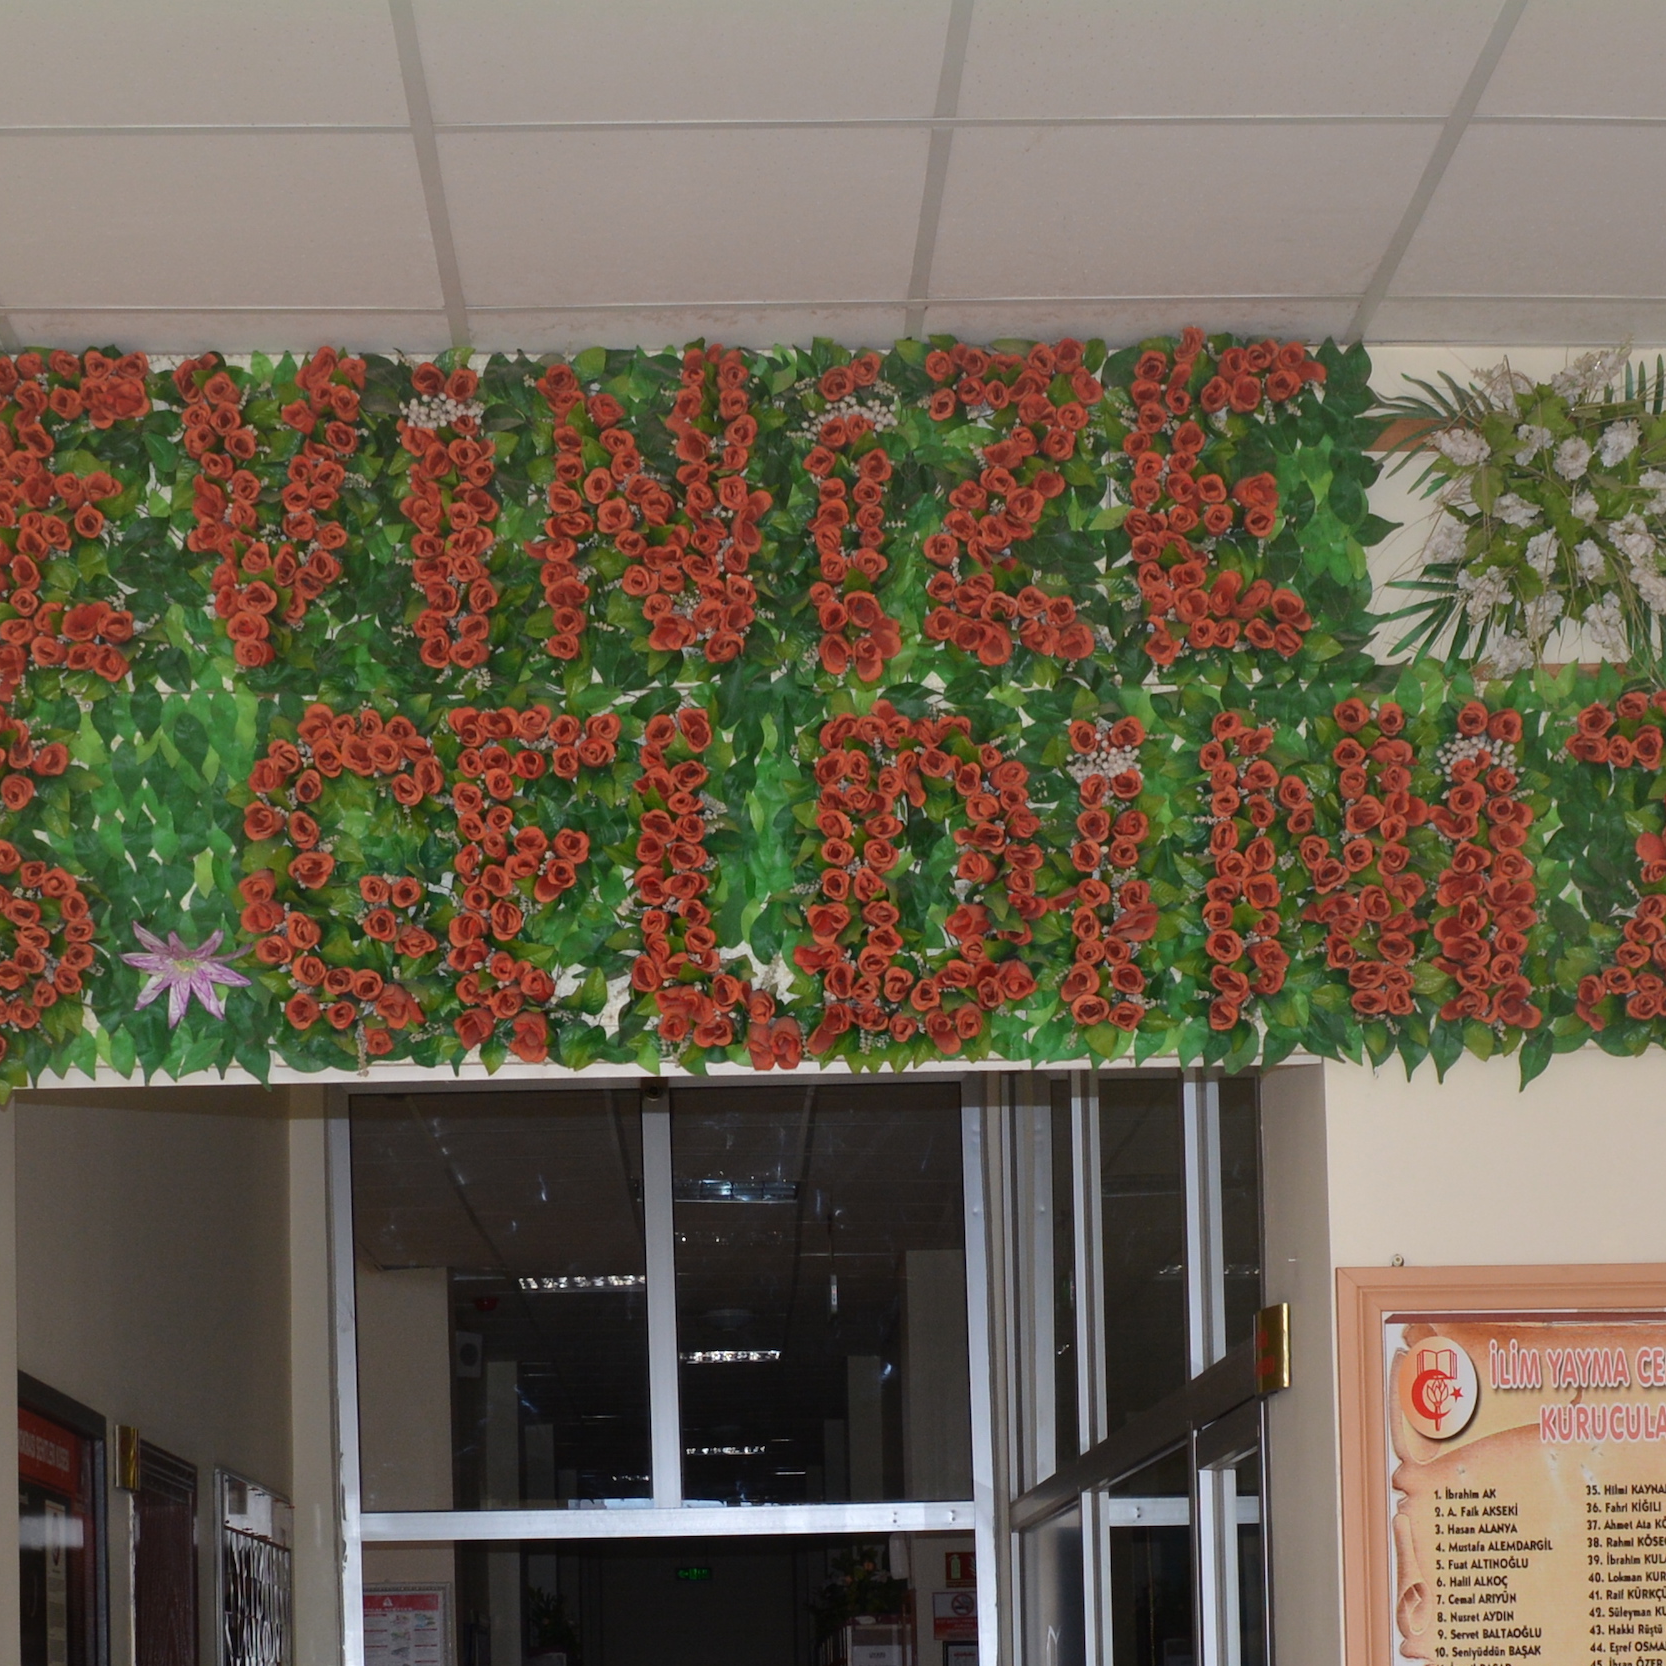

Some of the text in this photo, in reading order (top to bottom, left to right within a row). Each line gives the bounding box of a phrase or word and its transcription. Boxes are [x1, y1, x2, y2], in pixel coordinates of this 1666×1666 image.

[1489, 1338, 1542, 1390] İLİM
[1545, 1348, 1631, 1389] YAYMA
[1434, 1486, 1496, 1500] 1. İbrahim AK
[1435, 1522, 1518, 1535] 3. Hasan ALANYA
[1587, 1519, 1601, 1530] 37.
[1603, 1519, 1633, 1530] Ahmet
[1435, 1542, 1445, 1552] 4.
[1487, 1537, 1553, 1552] ALEMDARGİL
[1587, 1537, 1603, 1548] 38.
[1606, 1536, 1634, 1548] Rahmi
[1436, 1555, 1529, 1570] 5. Fuat ALTINOĞLU
[1587, 1554, 1603, 1565] 39.
[1607, 1551, 1641, 1565] İbrahim
[1588, 1572, 1605, 1583] 40.
[1608, 1571, 1643, 1582] Lokman
[1589, 1607, 1605, 1618] 42.
[1608, 1606, 1651, 1621] Süleyman
[1437, 1629, 1447, 1640] 9.
[1483, 1625, 1542, 1640] BALTAOĞLU
[1590, 1642, 1606, 1653] 44.
[1609, 1641, 1632, 1655] Eşref
